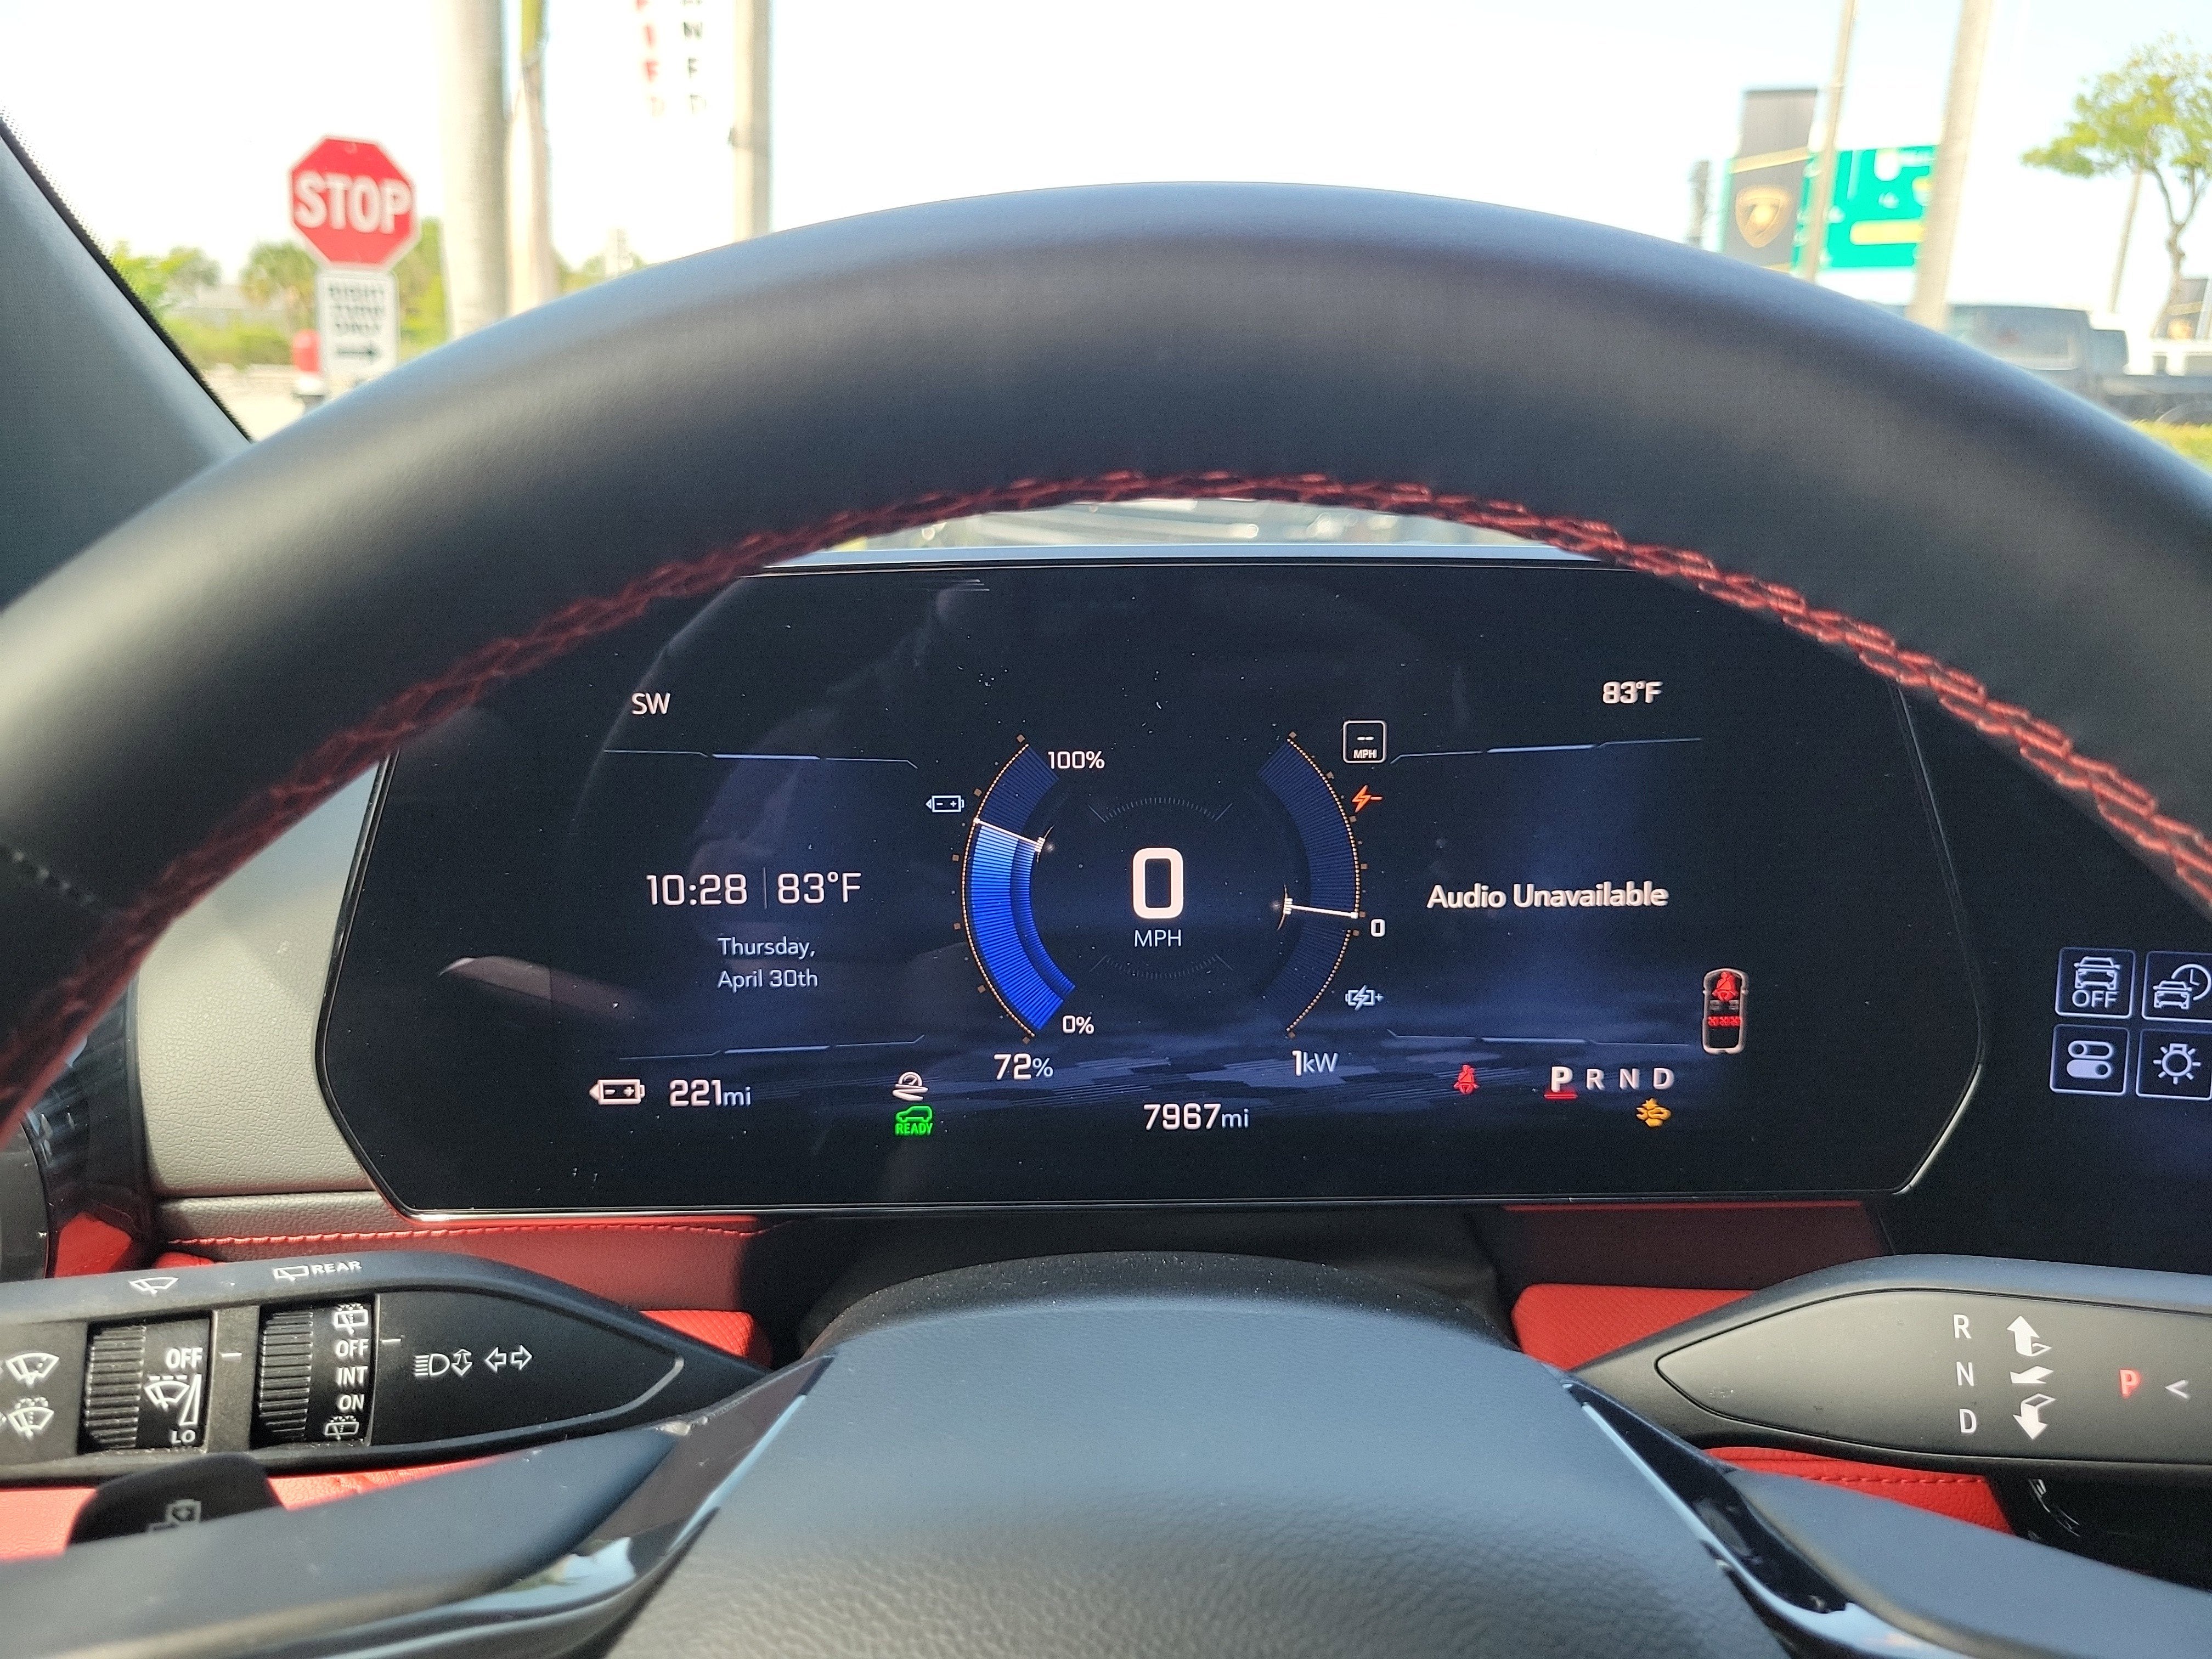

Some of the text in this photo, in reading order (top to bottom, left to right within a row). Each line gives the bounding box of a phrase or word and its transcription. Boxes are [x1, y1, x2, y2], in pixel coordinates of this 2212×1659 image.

[295, 170, 411, 234] STOP
[1603, 681, 1662, 703] 83°F
[632, 693, 670, 714] SW
[1048, 751, 1104, 769] 100%
[1353, 749, 1376, 758] MPH
[647, 872, 861, 905] 10:28 83°F
[1133, 848, 1183, 918] 0
[1427, 881, 1668, 908] Audio Unavailable
[1135, 929, 1181, 946] MPH
[1371, 919, 1385, 936] 0
[718, 936, 814, 959] Thursday,
[718, 969, 817, 992] April 30th
[2072, 990, 2118, 1008] OFF
[1063, 1015, 1094, 1034] 0%
[994, 1054, 1053, 1079] 72%
[1293, 1051, 1338, 1076] 1kW
[1551, 1066, 1674, 1092] P R N D
[895, 1122, 933, 1135] READY
[312, 1261, 362, 1275] REAR
[1954, 1314, 1971, 1339] R
[166, 1347, 202, 1369] OFF
[336, 1339, 368, 1357] OFF
[337, 1366, 368, 1385] INT
[1957, 1362, 1974, 1386] N
[2119, 1369, 2140, 1396] P
[339, 1395, 364, 1410] ON
[1960, 1409, 1977, 1433] D
[171, 1430, 195, 1444] LO
